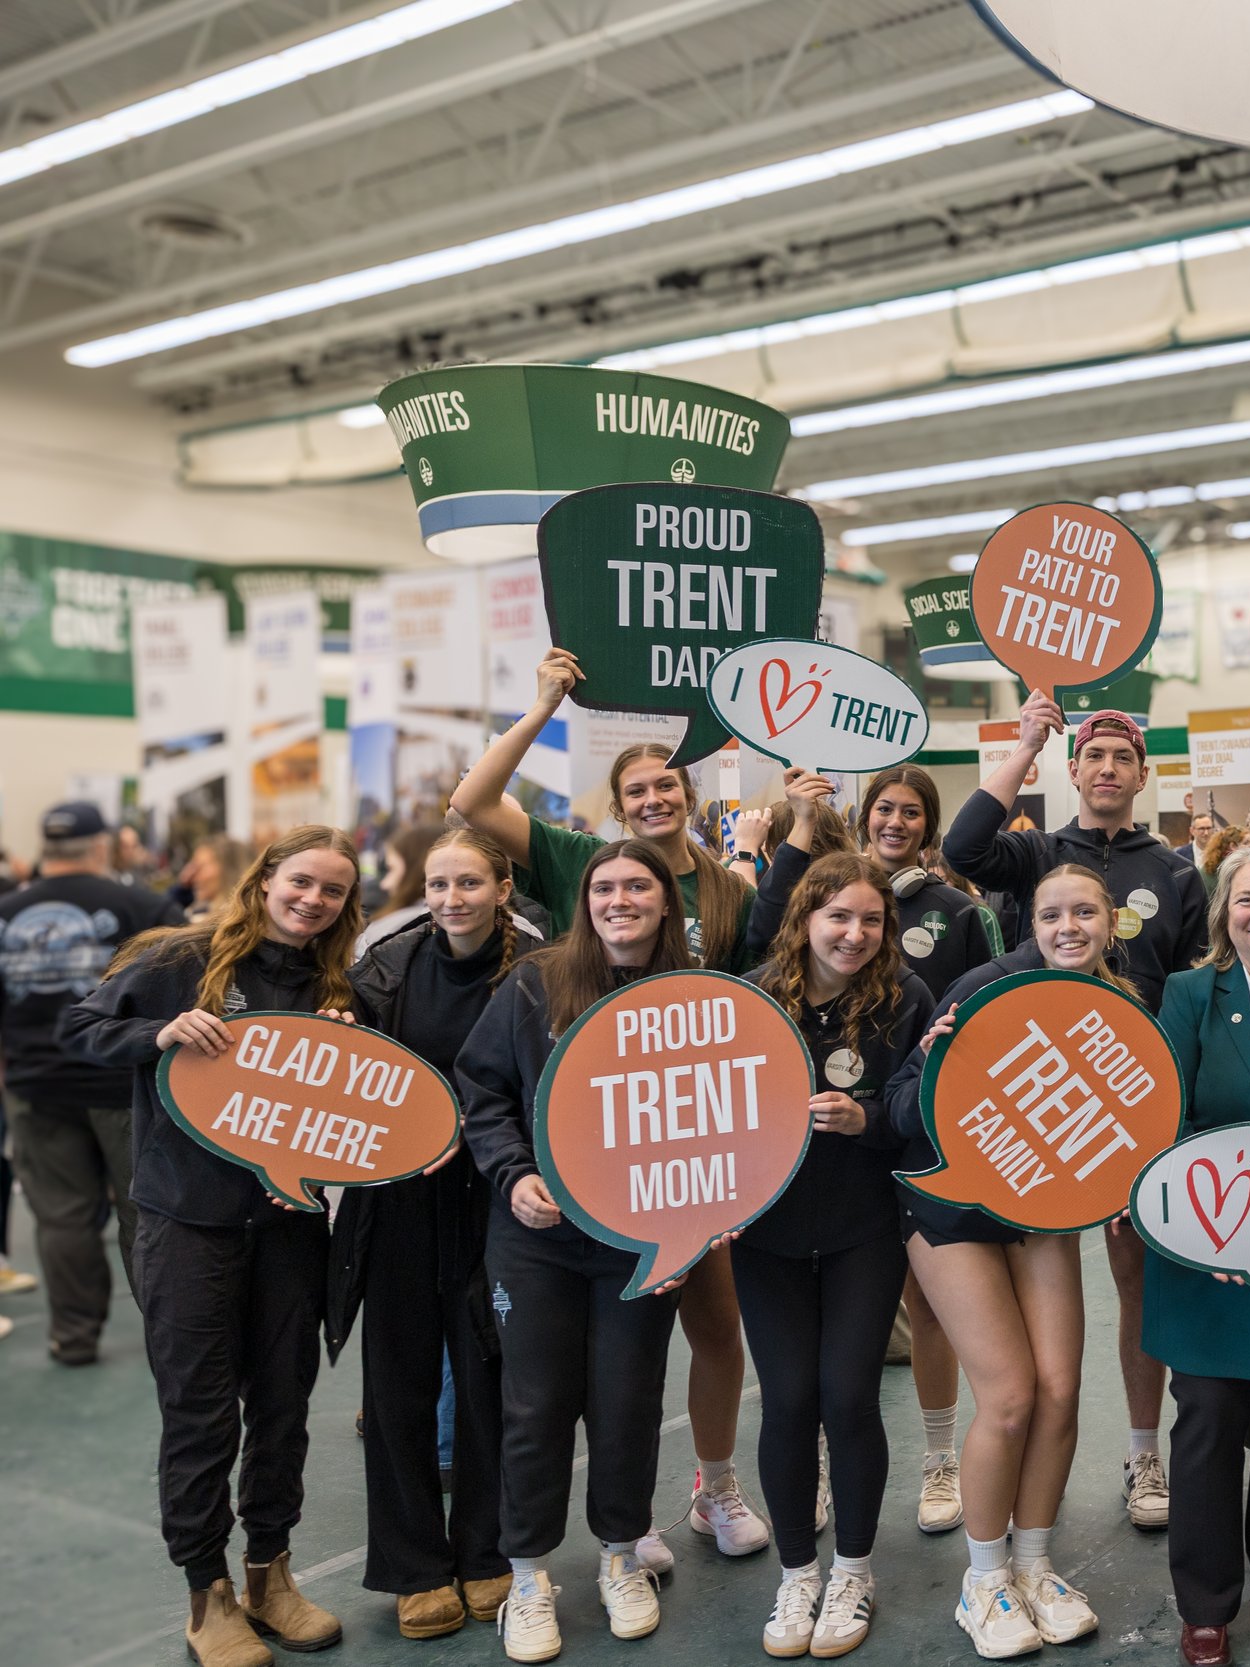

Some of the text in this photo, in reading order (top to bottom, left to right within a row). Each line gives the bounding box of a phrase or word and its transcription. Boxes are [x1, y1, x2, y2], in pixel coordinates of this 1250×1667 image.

[596, 393, 760, 456] HUMANITIES
[635, 503, 751, 552] PROUD
[1050, 515, 1117, 566] YOUR
[607, 560, 777, 633] TRENT
[910, 590, 970, 617] SOCIAL SCIE
[1017, 548, 1121, 608] PATH TO
[995, 585, 1121, 668] TRENT
[651, 645, 733, 688] DAD
[730, 667, 918, 747] I TRENT
[1197, 752, 1234, 765] LAW DUAL
[1197, 766, 1224, 778] DEGREE
[924, 921, 946, 931] BIOLOGY
[615, 996, 736, 1057] PROUD
[235, 1024, 415, 1108] GLAD YOU
[1064, 1008, 1157, 1109] PROUD
[211, 1092, 389, 1170] ARE HERE
[590, 1055, 767, 1149] TRENT
[986, 1018, 1138, 1183] TRENT
[957, 1097, 1055, 1198] FAMILY
[629, 1152, 737, 1213] MOM!
[1161, 1182, 1169, 1224] I
